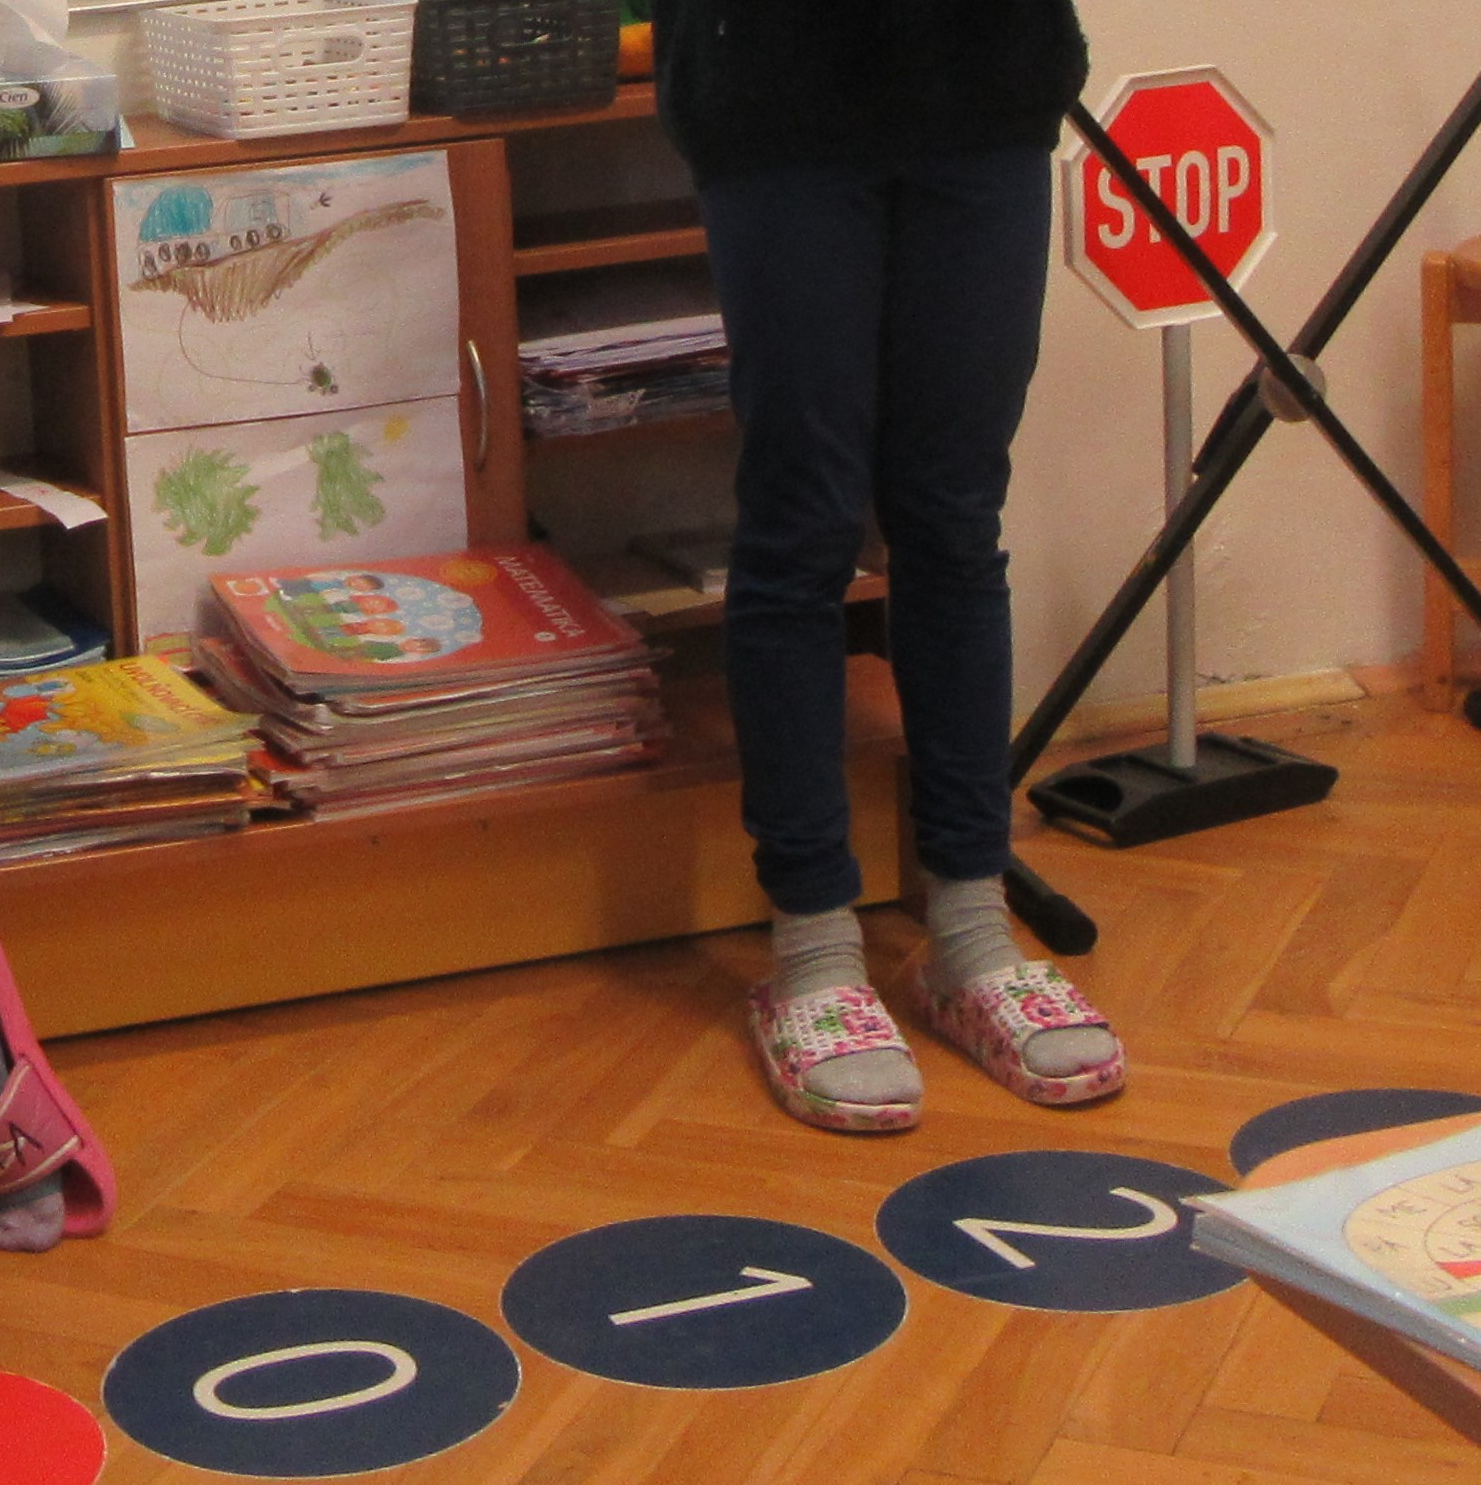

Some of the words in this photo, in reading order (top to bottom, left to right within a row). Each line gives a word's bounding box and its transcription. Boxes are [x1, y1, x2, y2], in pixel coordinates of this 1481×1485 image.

[1097, 145, 1250, 249] STOP
[494, 556, 585, 638] MATEMATIKA
[954, 1188, 1180, 1270] 2
[609, 1267, 812, 1325] 1
